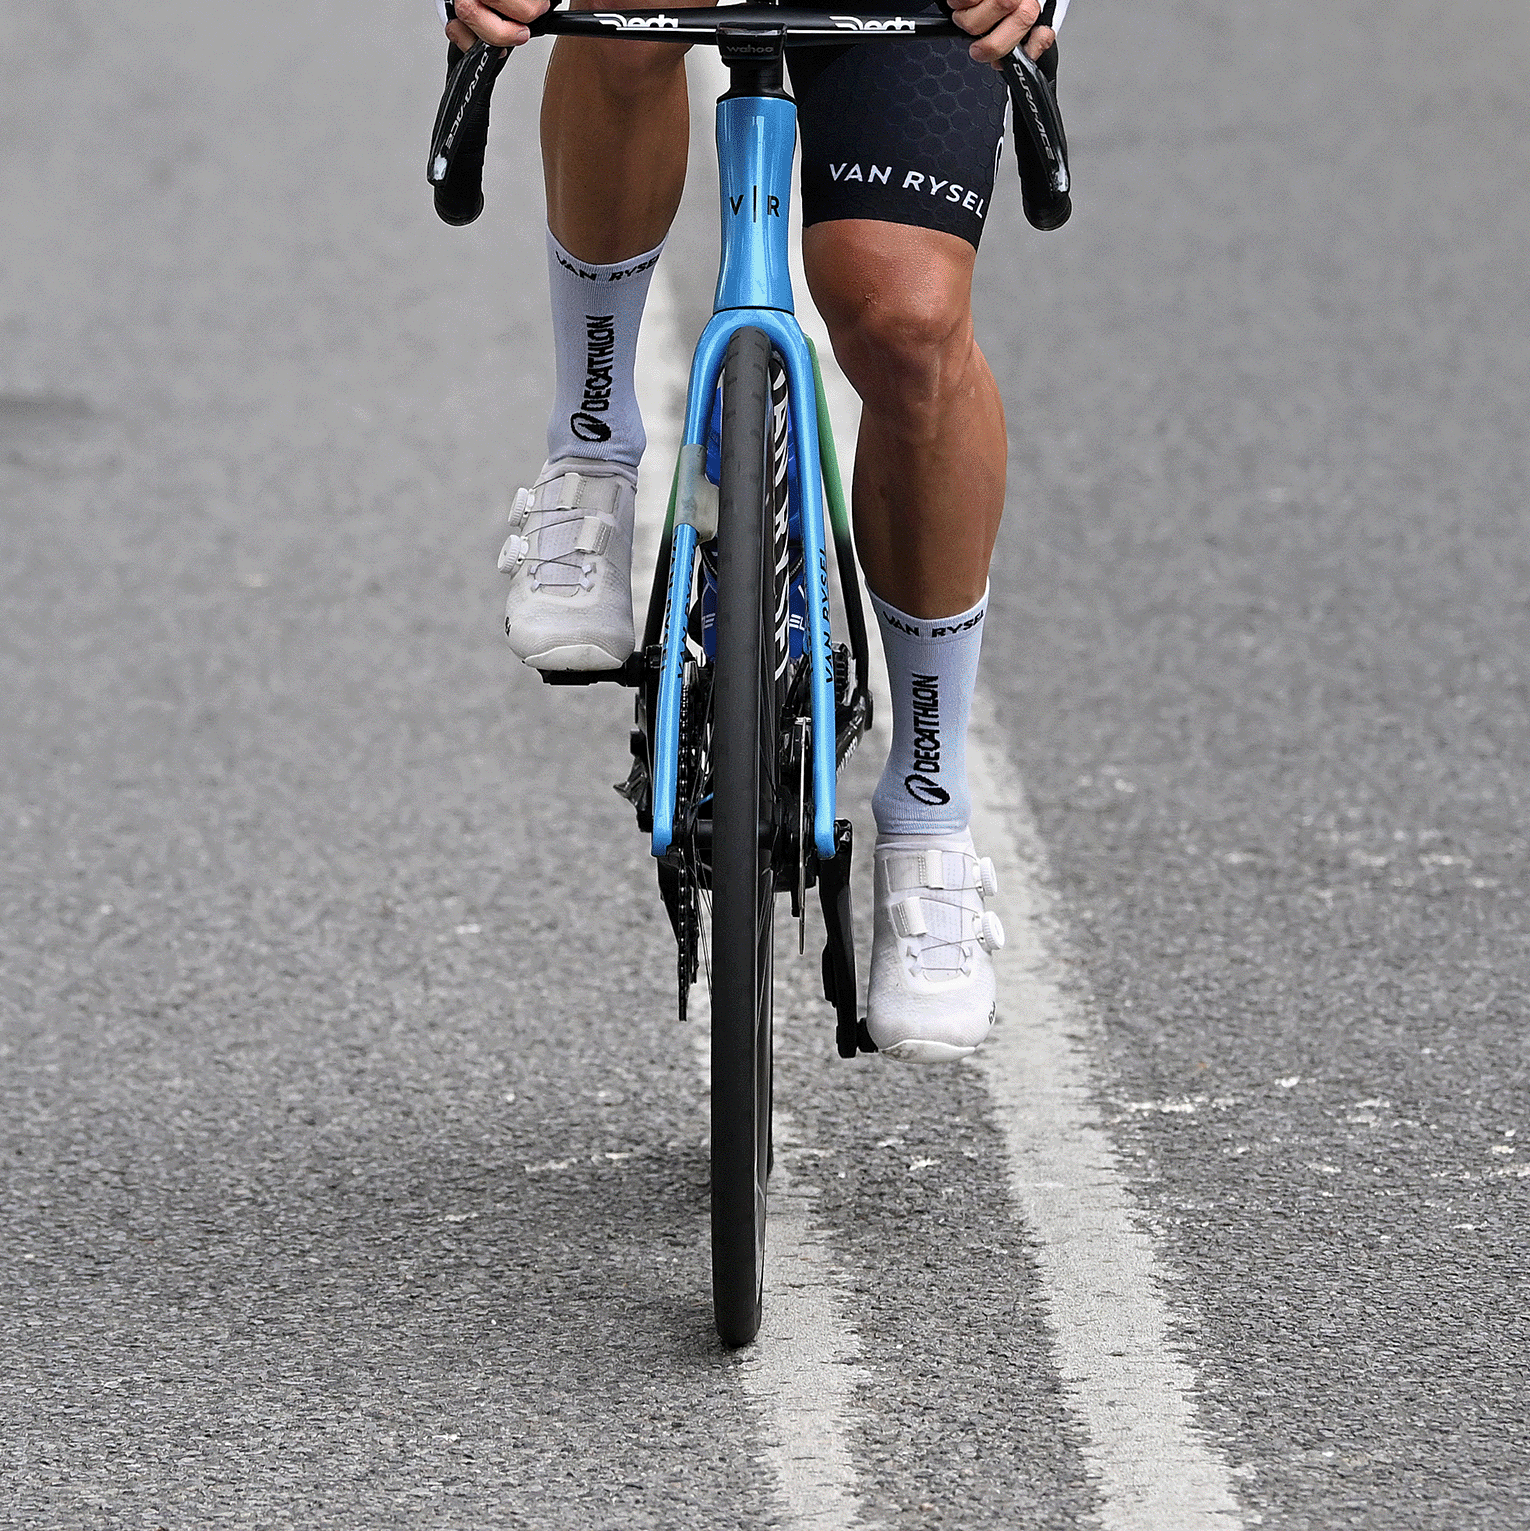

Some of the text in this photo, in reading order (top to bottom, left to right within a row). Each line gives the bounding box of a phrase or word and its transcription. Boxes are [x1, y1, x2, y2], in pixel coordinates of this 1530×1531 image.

[726, 43, 774, 54] wahoo
[1012, 63, 1056, 160] DURA-ACE
[828, 162, 985, 219] VAN RYSEL
[555, 250, 598, 282] VAN
[581, 314, 615, 412] DECATHLON
[882, 611, 920, 637] VAN
[911, 672, 941, 773] DECATHLON
